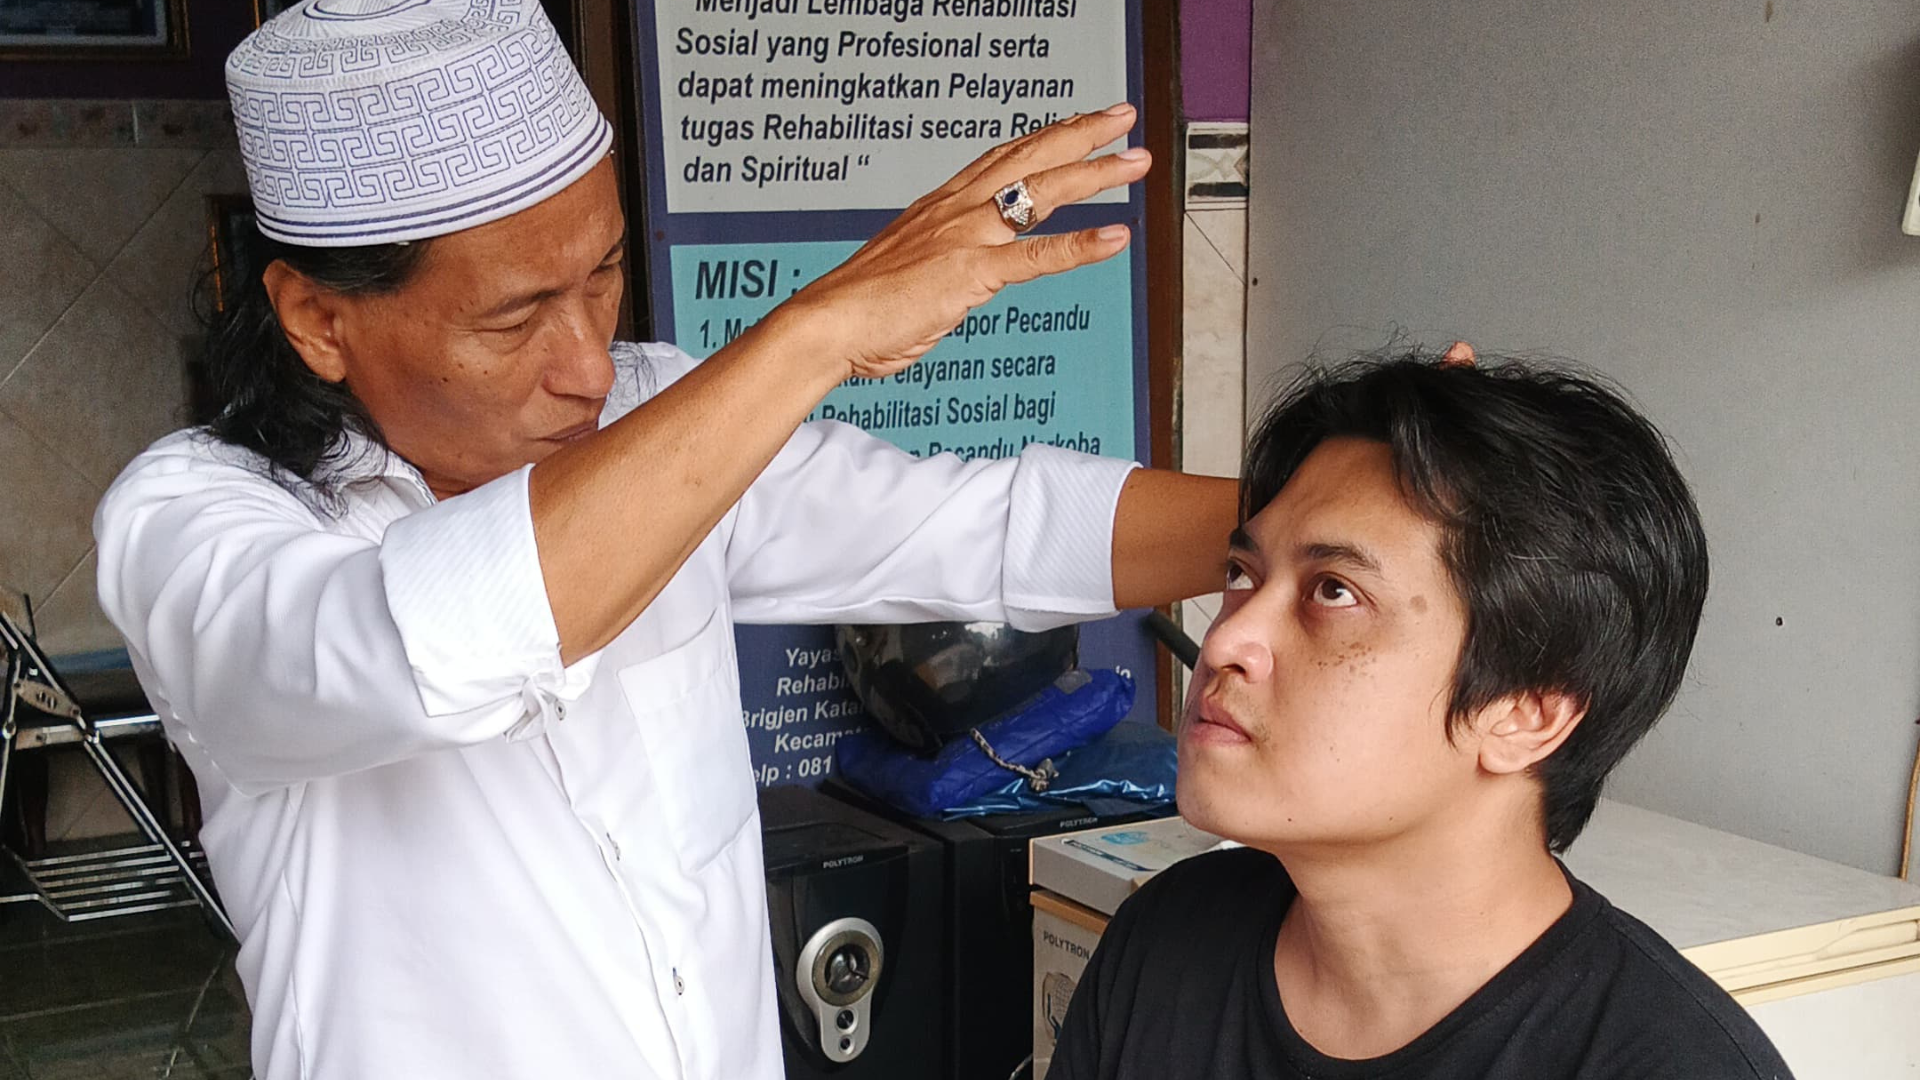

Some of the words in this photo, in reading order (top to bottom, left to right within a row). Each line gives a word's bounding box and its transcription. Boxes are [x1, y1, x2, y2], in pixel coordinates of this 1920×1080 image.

[807, 0, 923, 23] Lembaga
[932, 0, 1077, 18] Rehabilitasi
[676, 27, 759, 55] Sosial
[766, 36, 829, 64] yang
[838, 31, 982, 58] Profesional
[988, 33, 1050, 58] serta
[678, 70, 754, 105] dapat
[761, 72, 940, 105] meningkatkan
[948, 72, 1074, 105] Pelayanan
[681, 115, 755, 147] tugas
[763, 113, 914, 140] Rehabilitasi
[920, 118, 1002, 139] secara
[683, 156, 732, 183] dan
[741, 155, 849, 189] Spiritual
[695, 259, 778, 300] MISI
[700, 319, 717, 349] 1.
[943, 314, 1002, 343] apor
[1006, 303, 1091, 334] Pecandu
[880, 358, 985, 390] elayanan
[990, 354, 1056, 378] secara
[822, 398, 941, 431] Rehabilitasi
[946, 393, 1008, 424] Sosial
[1014, 390, 1056, 425] bagi
[785, 647, 841, 669] Yayas
[814, 699, 865, 720] Kata
[752, 763, 780, 788] elp
[1043, 929, 1090, 960] POLYTRON
